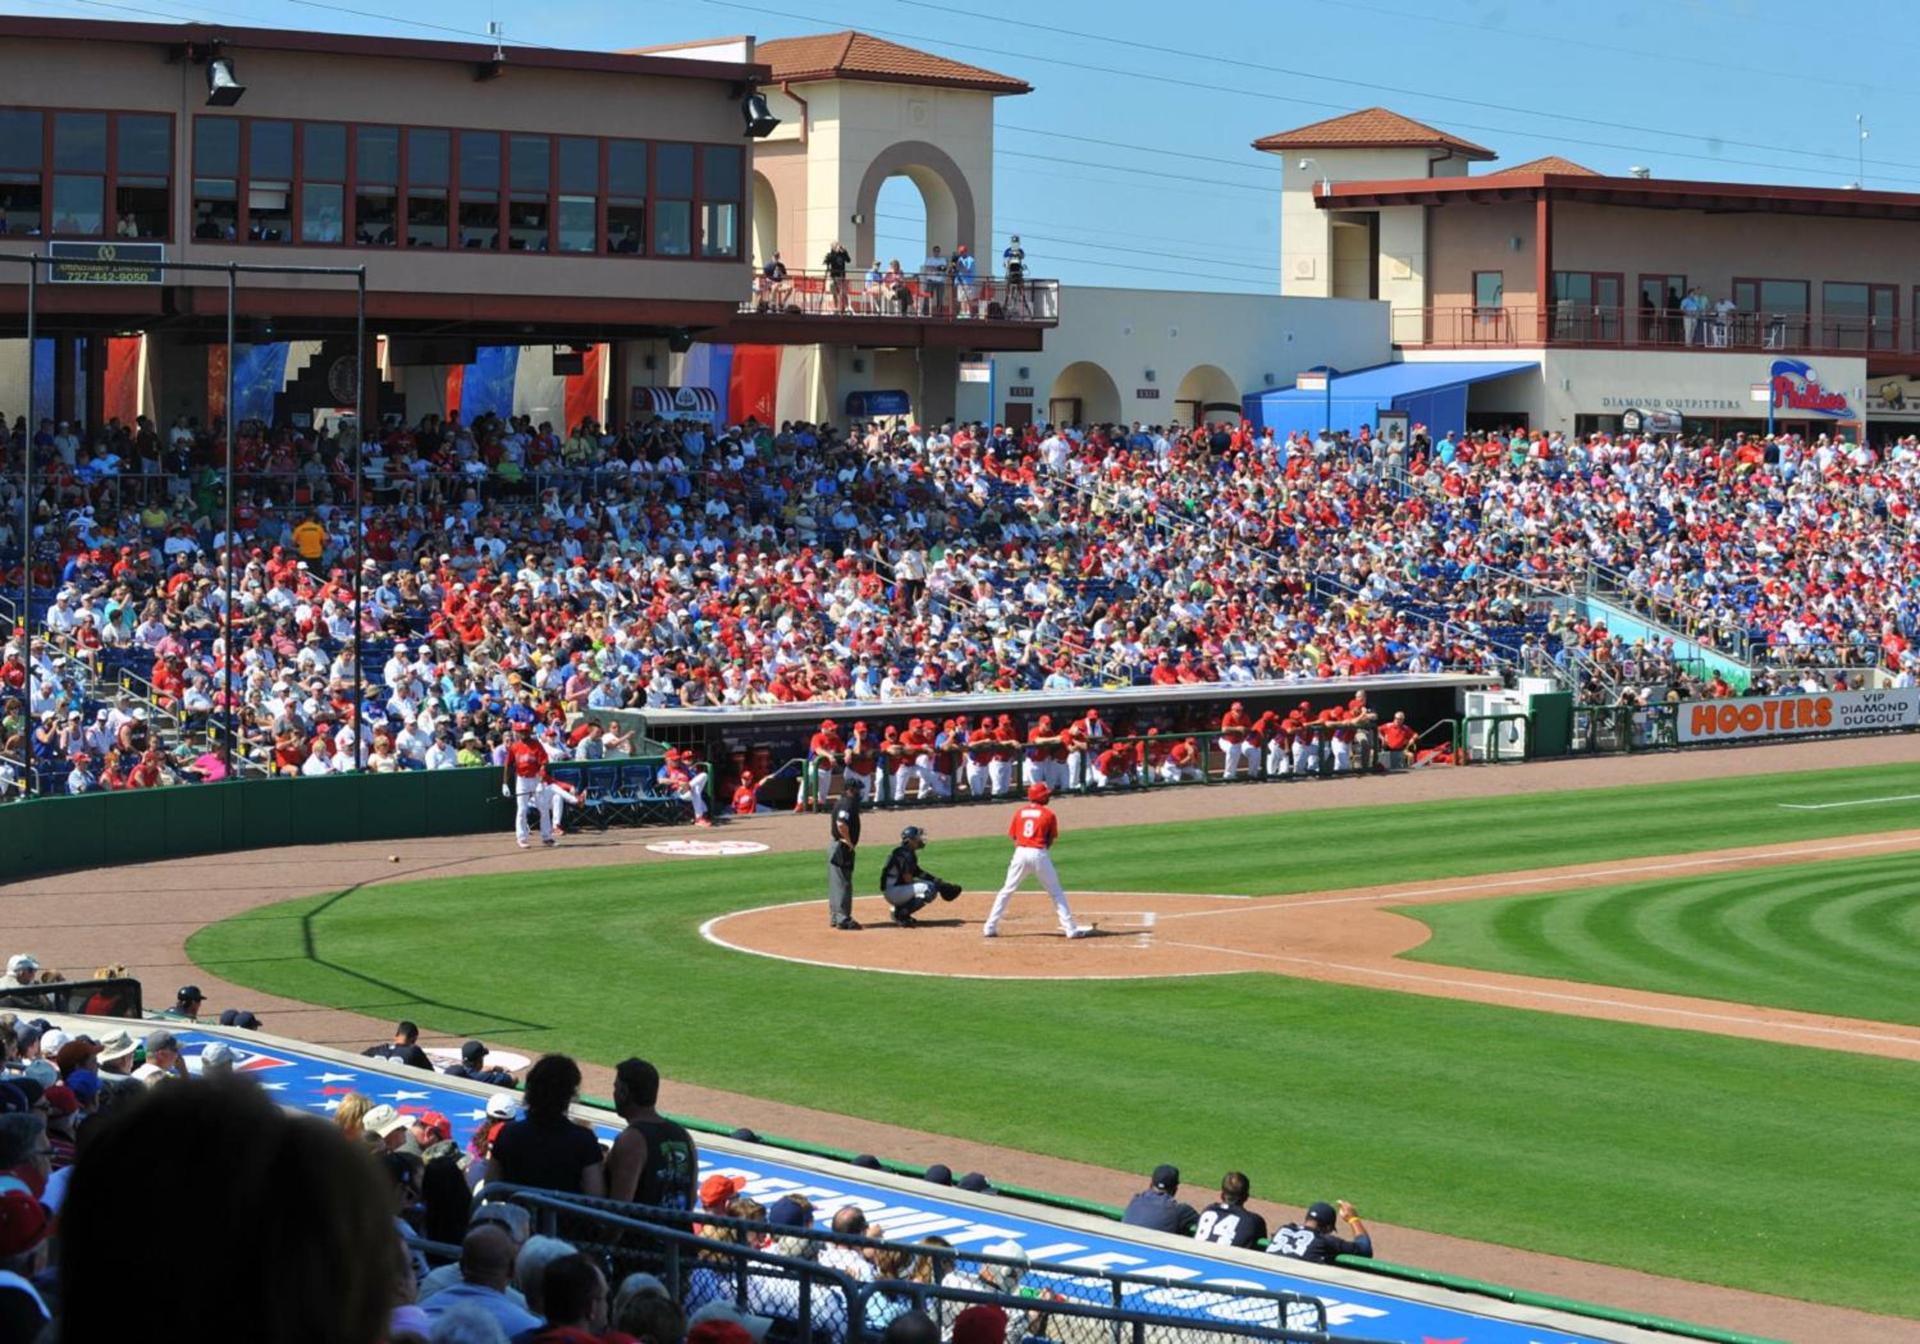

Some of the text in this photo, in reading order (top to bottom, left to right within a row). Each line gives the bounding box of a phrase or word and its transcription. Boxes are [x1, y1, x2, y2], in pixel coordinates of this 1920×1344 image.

[1603, 397, 1741, 409] DIAMOND OUTFITTERS
[1862, 693, 1885, 704] VIP
[1840, 701, 1909, 715] DIAMOND
[1691, 697, 1833, 736] HOOTERS
[1843, 712, 1904, 726] DUGOUT
[1023, 819, 1034, 838] 8
[1195, 1210, 1241, 1247] 84
[1265, 1227, 1314, 1257] 53
